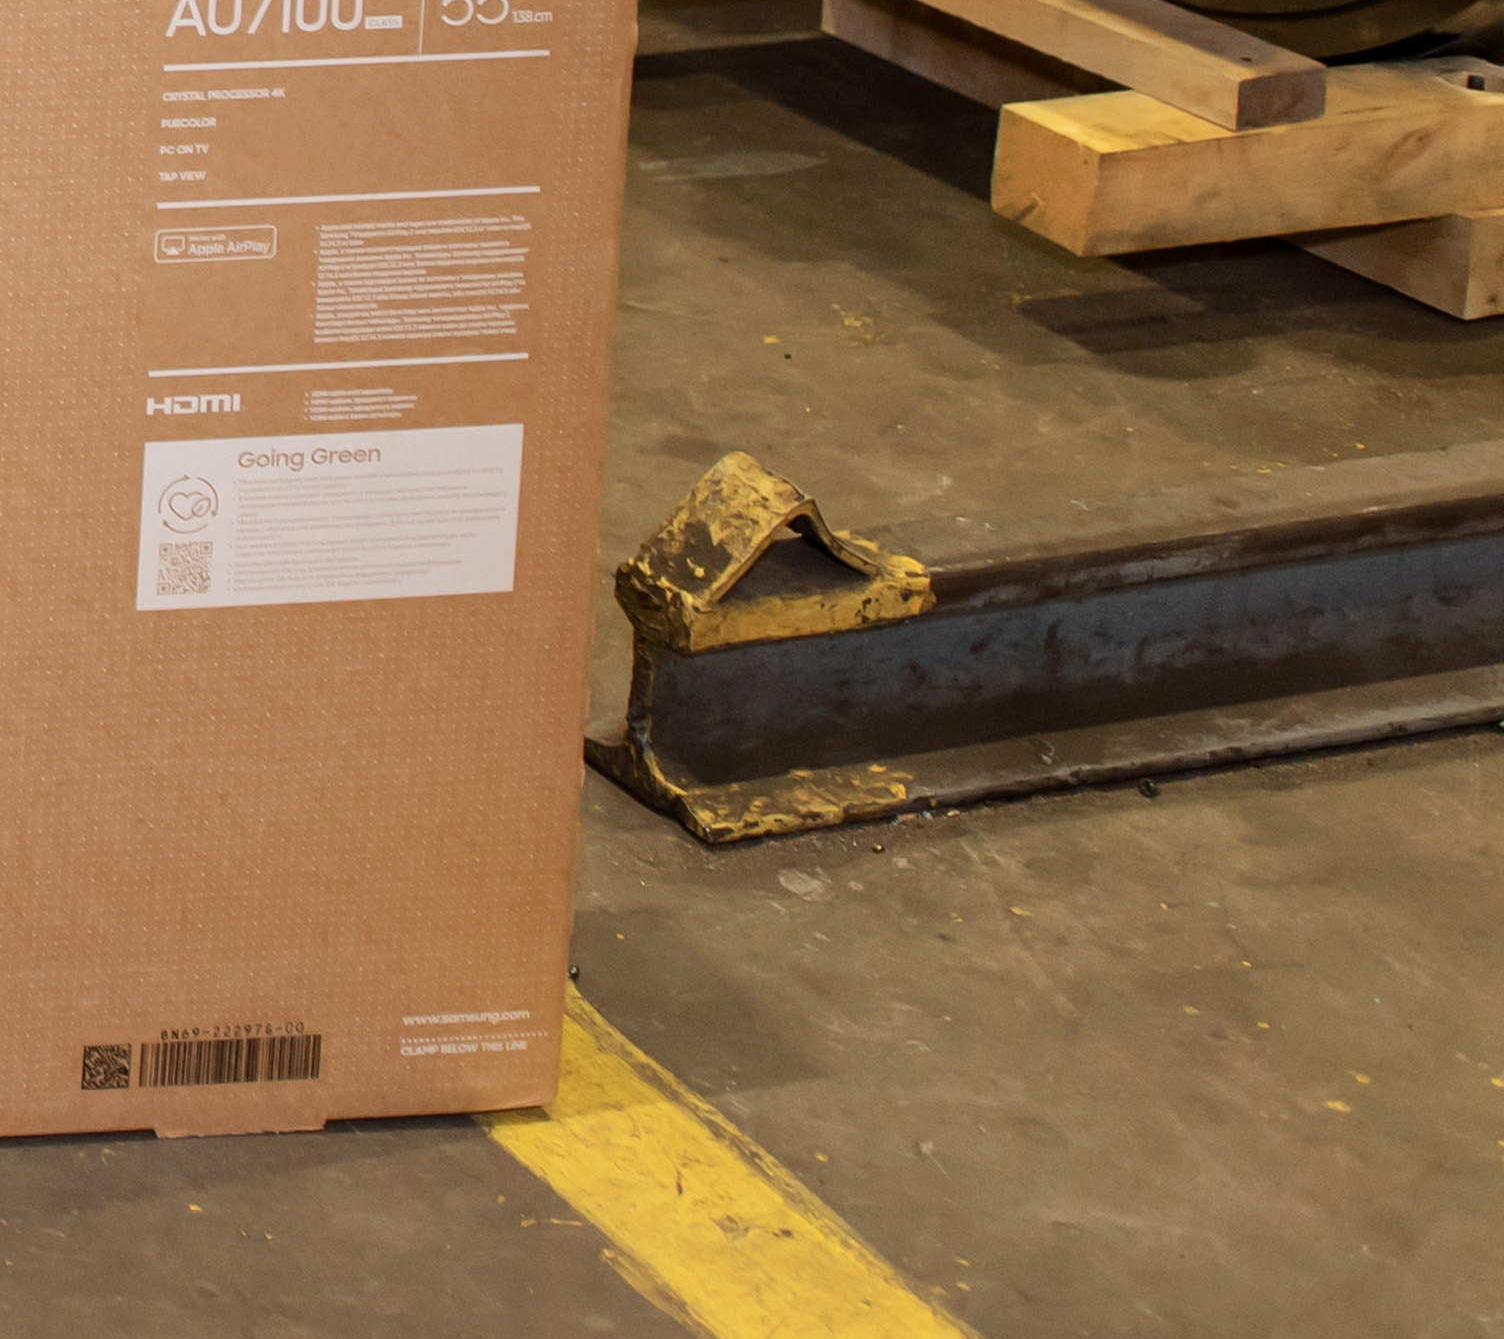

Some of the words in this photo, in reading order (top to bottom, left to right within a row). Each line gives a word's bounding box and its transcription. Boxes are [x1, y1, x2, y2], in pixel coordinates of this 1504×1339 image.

[195, 143, 210, 154] TV
[146, 393, 241, 416] HDMI
[238, 447, 304, 472] Going
[311, 447, 381, 465] Green
